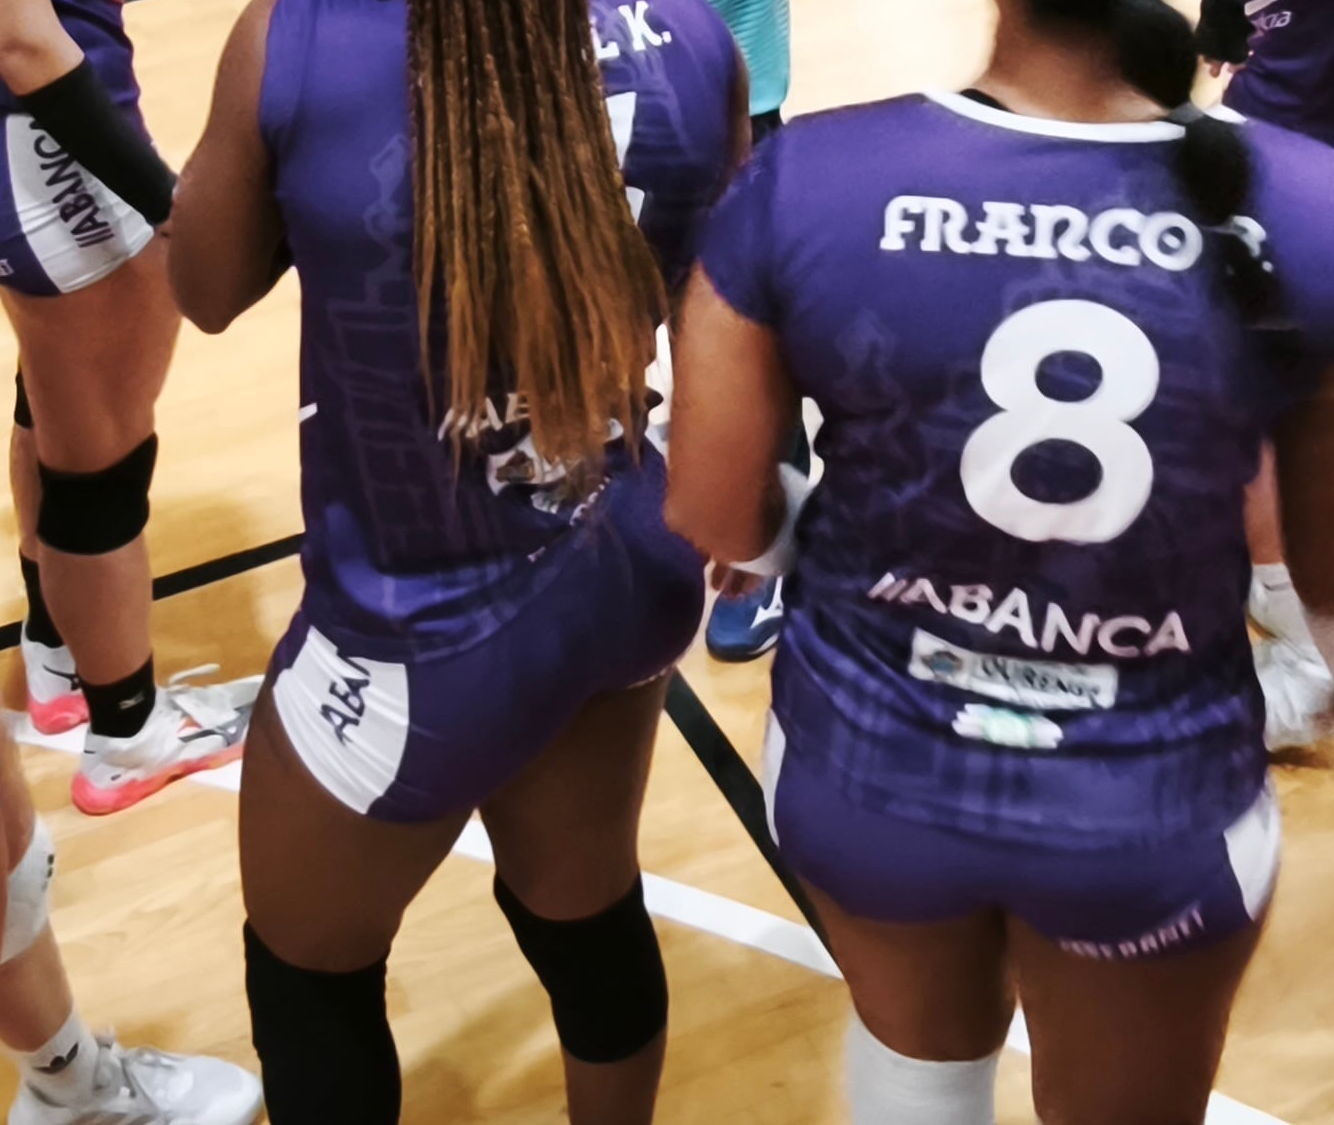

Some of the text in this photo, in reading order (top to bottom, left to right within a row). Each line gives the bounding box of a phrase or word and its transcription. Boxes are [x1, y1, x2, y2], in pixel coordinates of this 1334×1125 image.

[30, 118, 115, 249] ABANC
[879, 194, 1204, 272] FRANCO
[958, 299, 1160, 545] 8
